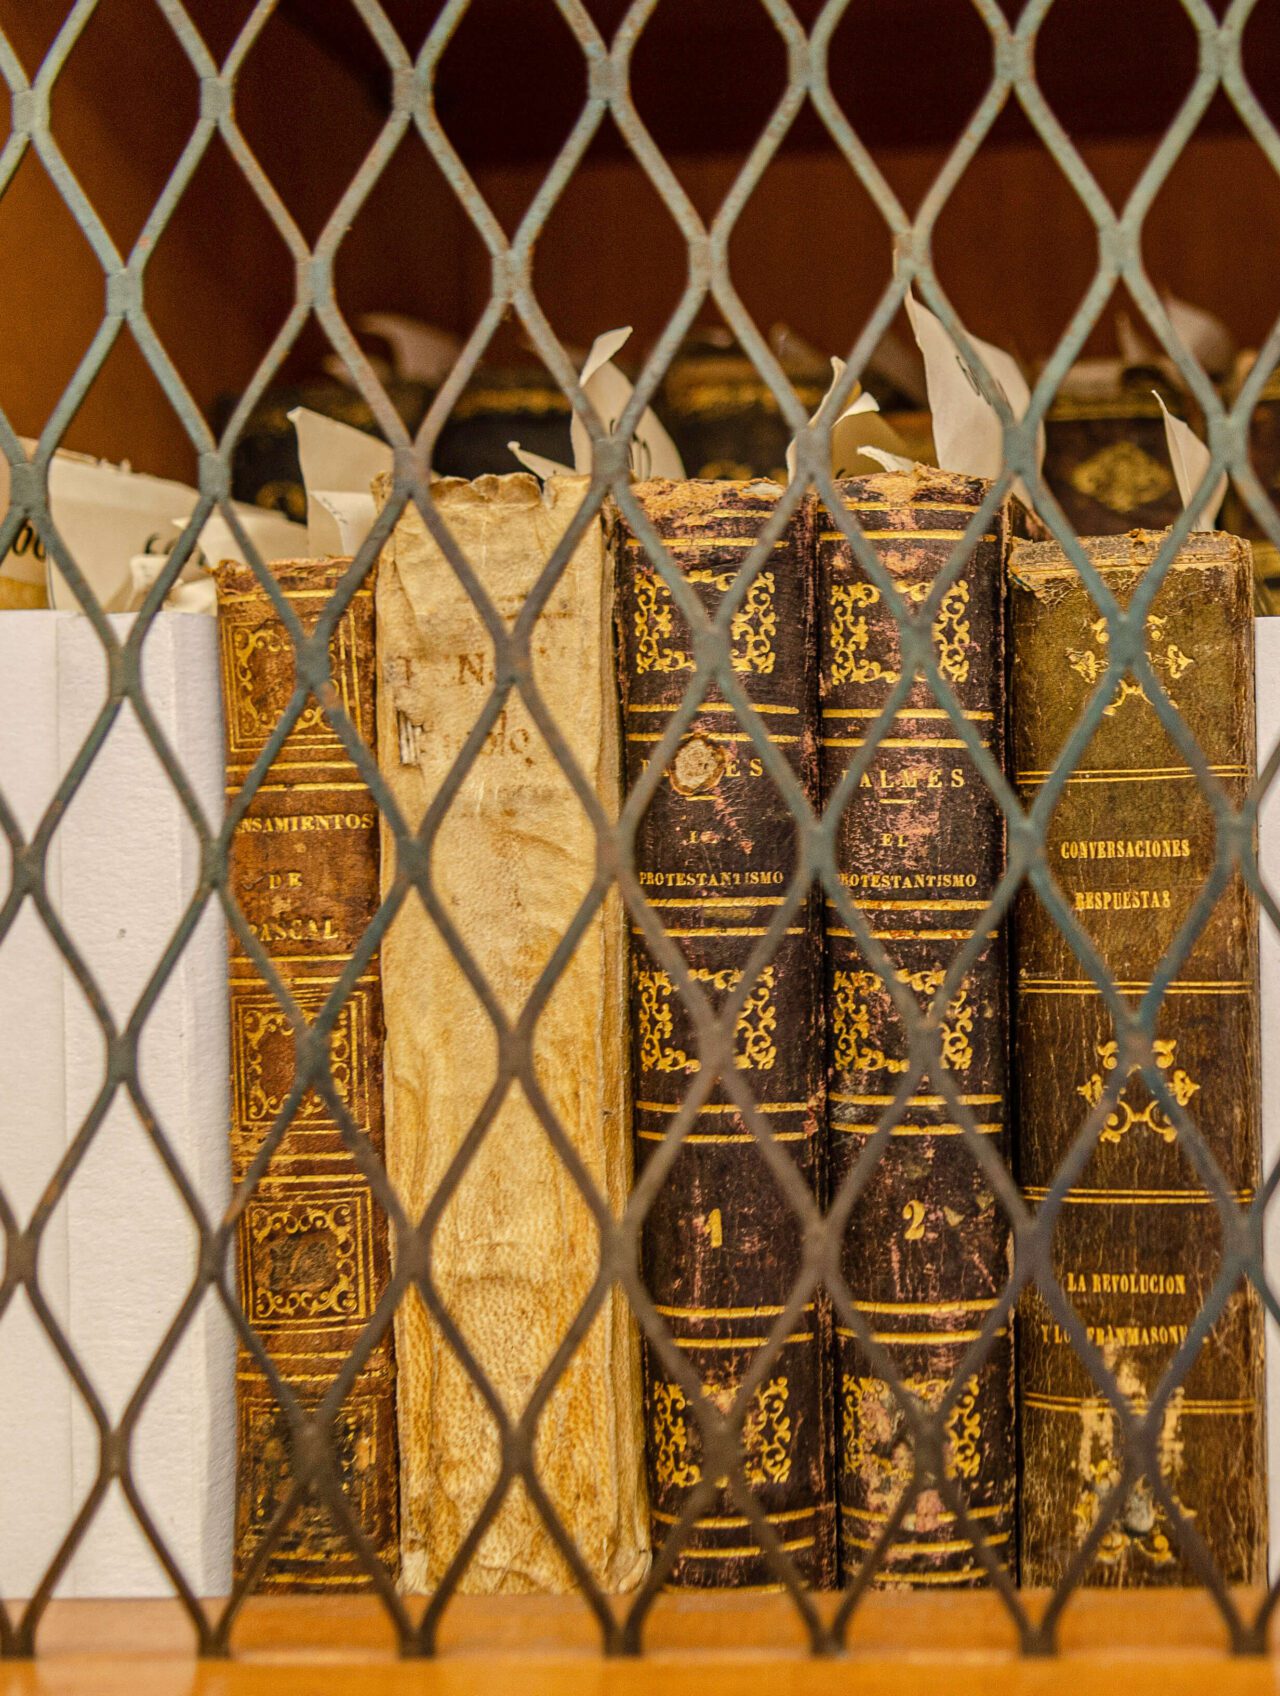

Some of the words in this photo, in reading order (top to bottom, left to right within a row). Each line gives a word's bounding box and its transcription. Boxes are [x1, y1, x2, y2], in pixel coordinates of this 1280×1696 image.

[235, 813, 375, 834] NSAMIENTOS
[880, 833, 909, 847] EL
[1060, 839, 1191, 859] CONVERSACIONES
[269, 872, 303, 889] DE
[639, 870, 785, 887] PROTESTANTISMO
[838, 873, 977, 889] ROTESTANTISMO
[704, 1207, 723, 1249] 1
[902, 1199, 926, 1241] 2
[1067, 1271, 1087, 1293] LA
[1092, 1272, 1187, 1295] REVOLUCION
[1053, 1323, 1075, 1345] LO
